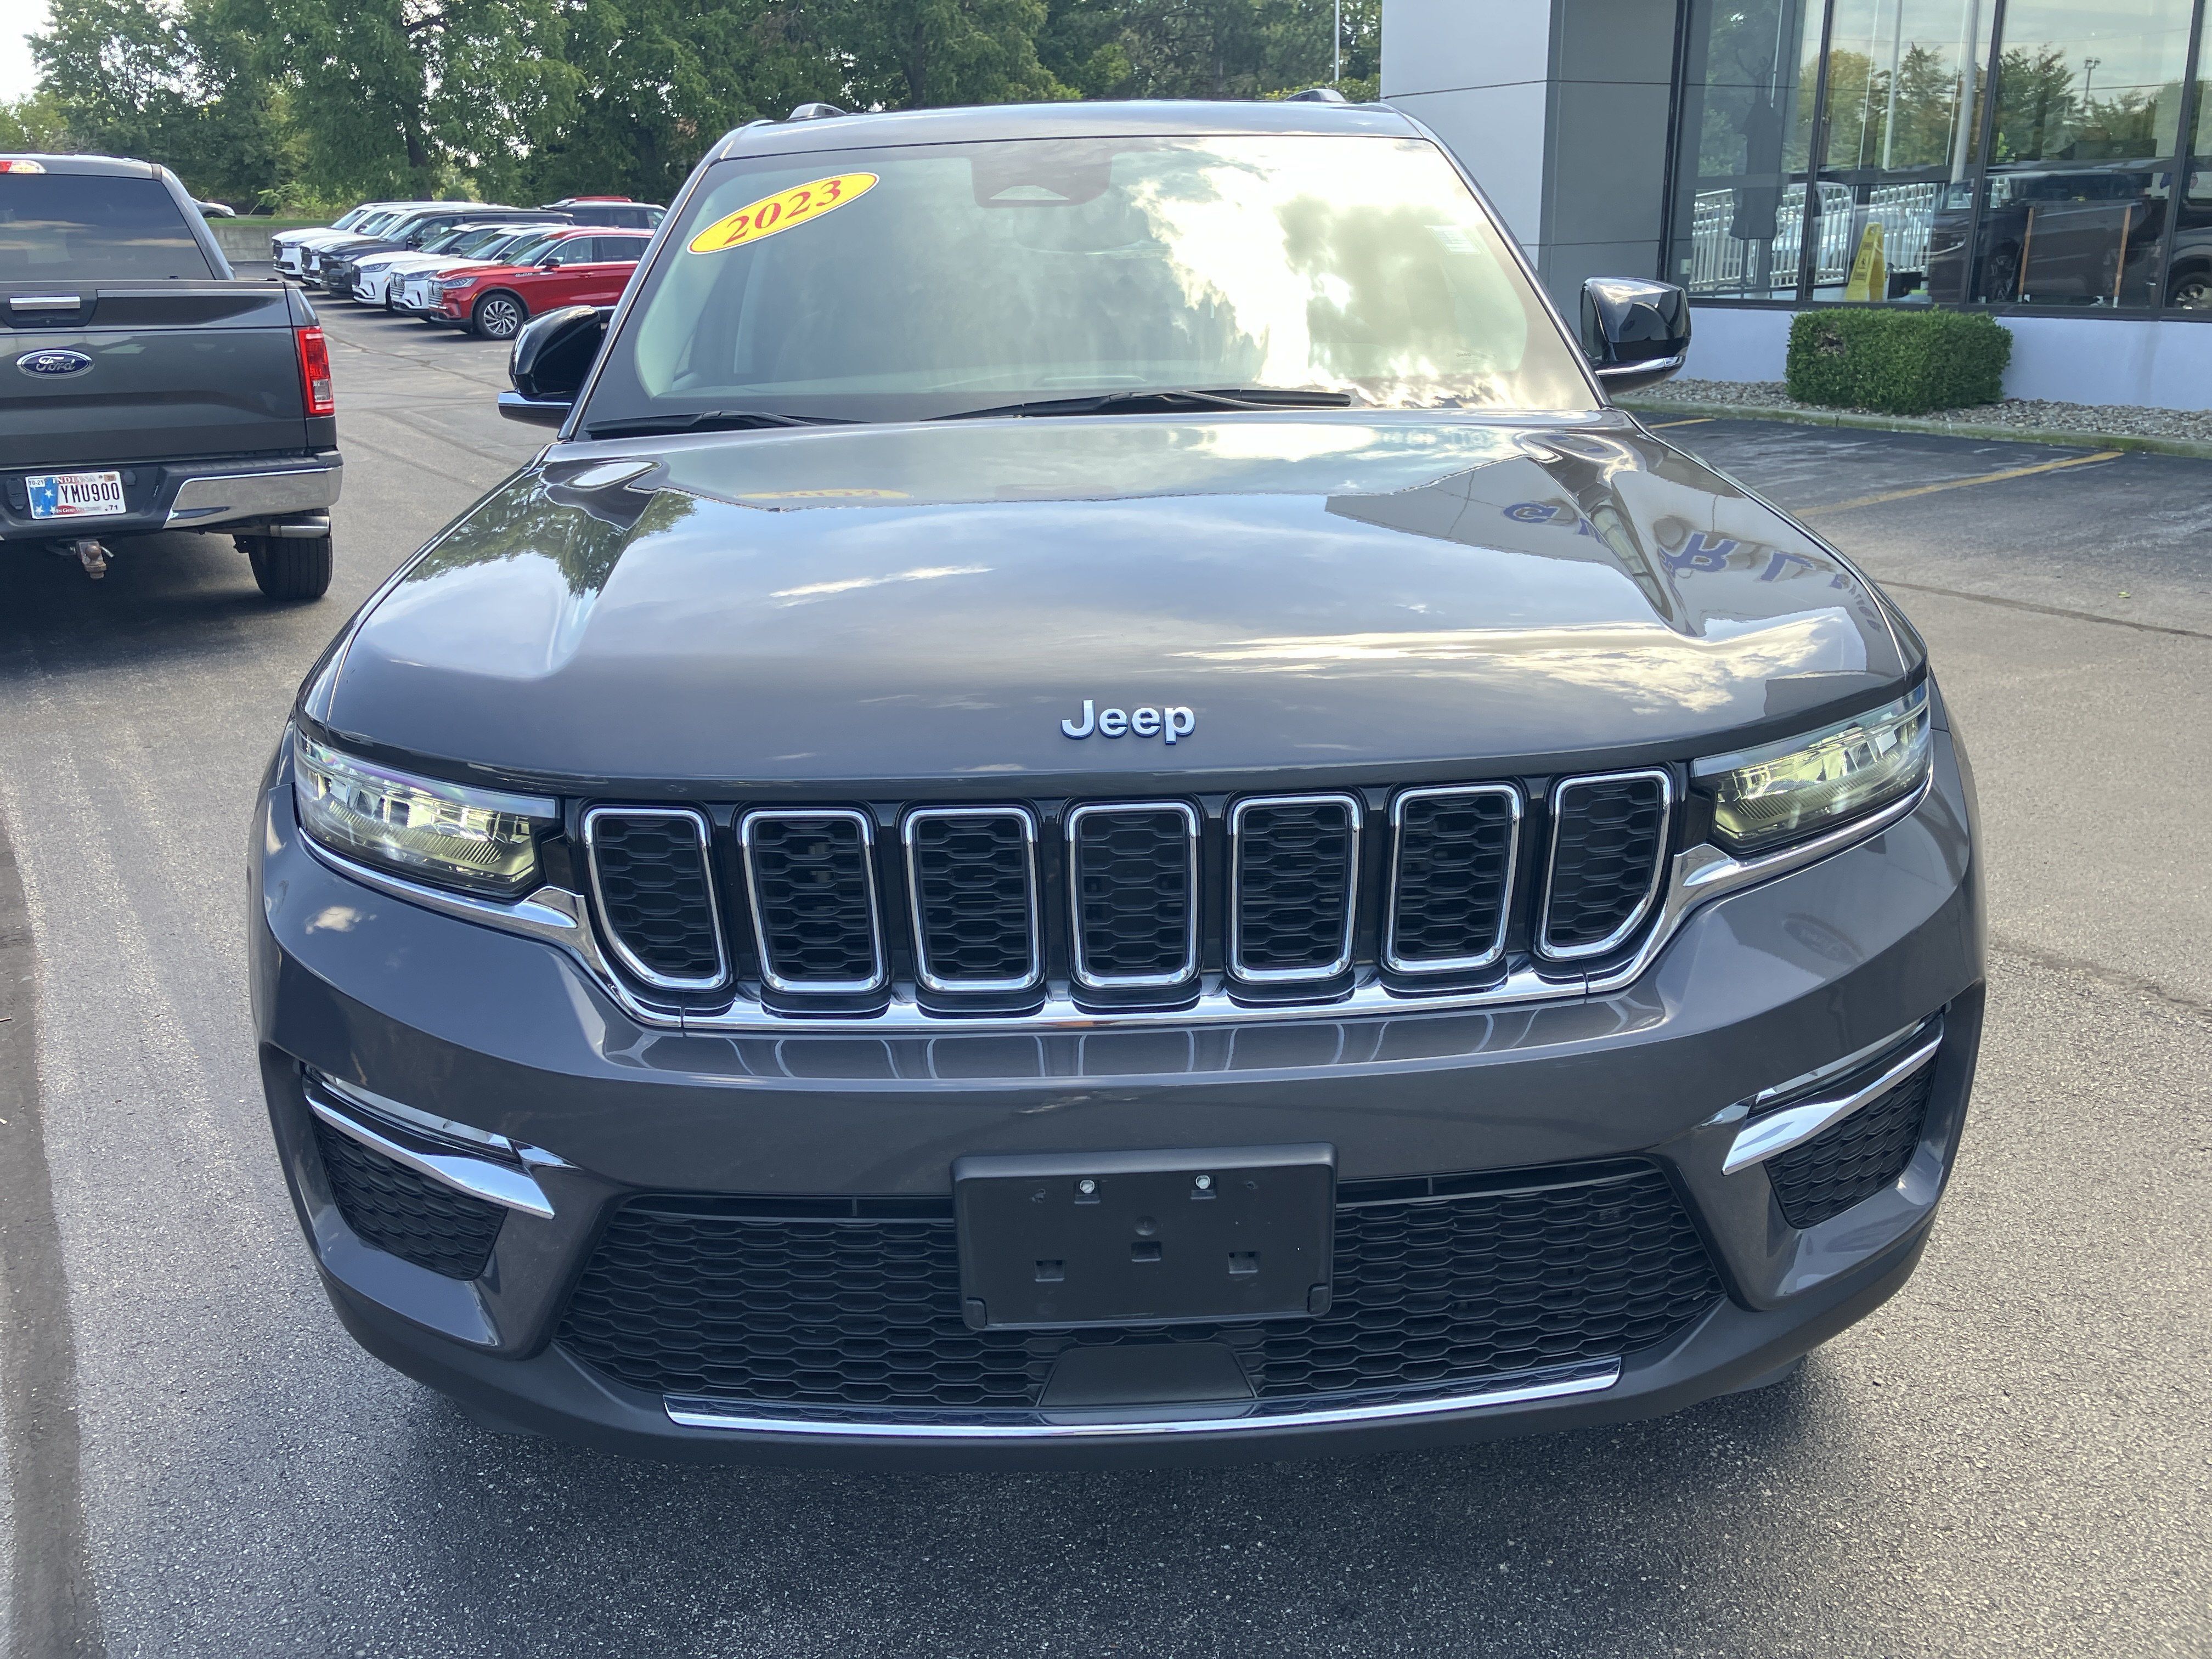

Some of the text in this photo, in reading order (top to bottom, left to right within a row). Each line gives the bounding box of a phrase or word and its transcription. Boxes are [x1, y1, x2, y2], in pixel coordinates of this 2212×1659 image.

[723, 180, 842, 246] 2023
[36, 356, 76, 371] Ford
[53, 475, 96, 484] INDIANA
[60, 482, 120, 503] YMU900
[1061, 699, 1195, 746] Jeep
